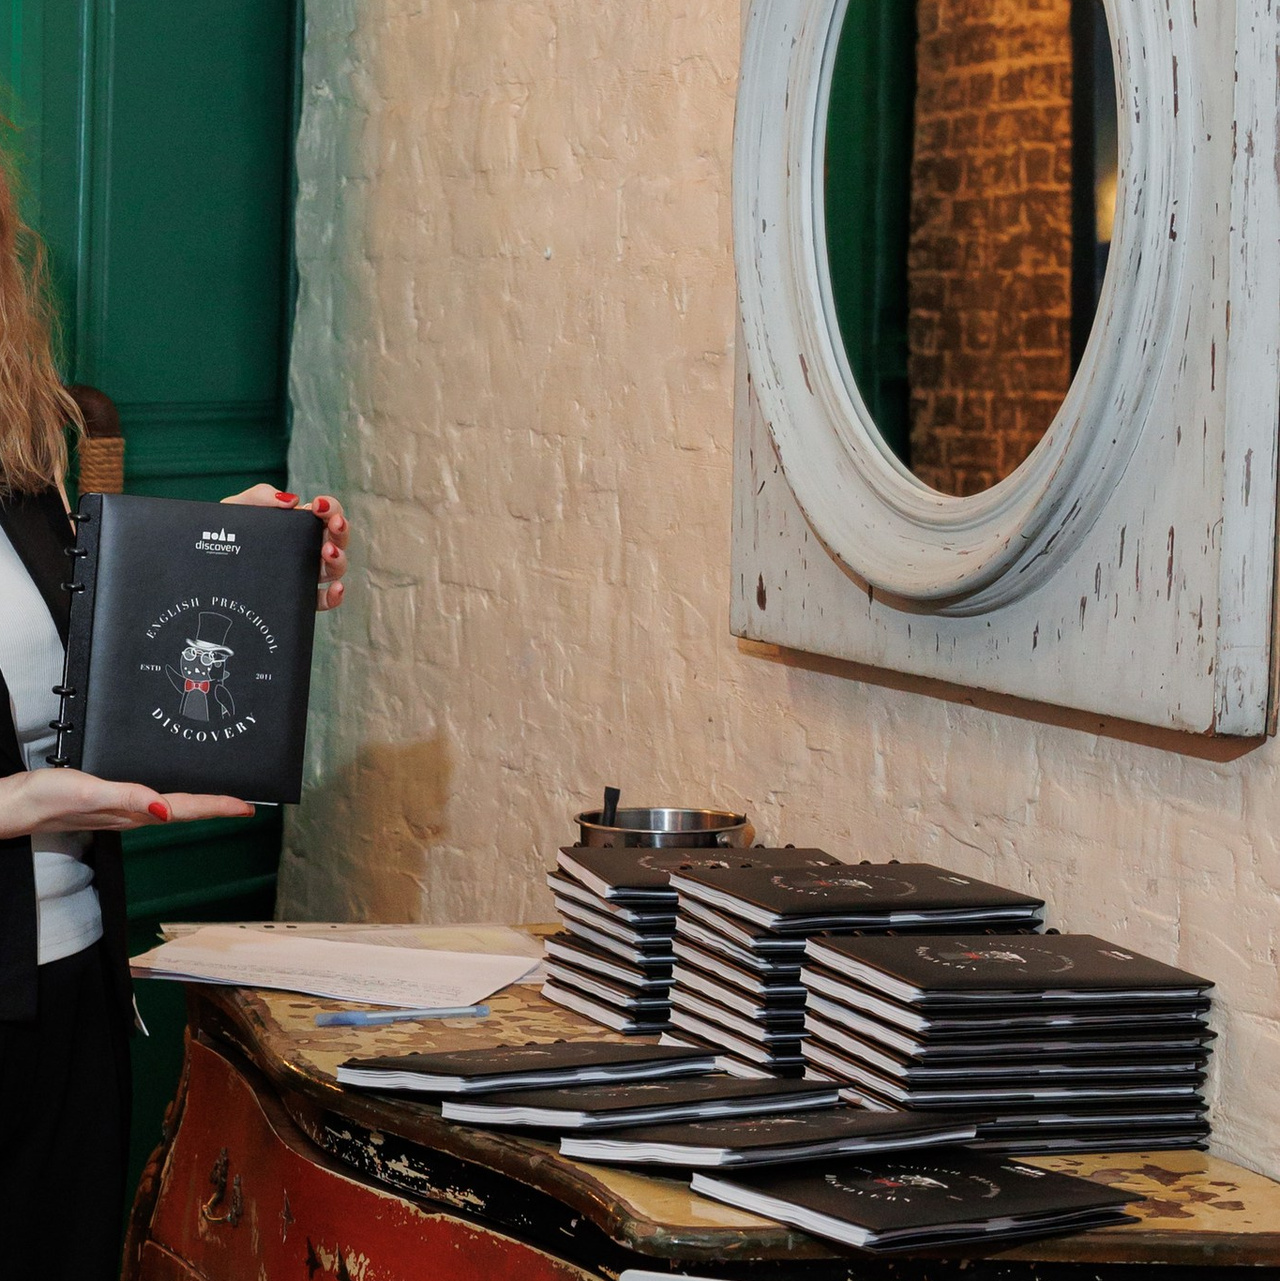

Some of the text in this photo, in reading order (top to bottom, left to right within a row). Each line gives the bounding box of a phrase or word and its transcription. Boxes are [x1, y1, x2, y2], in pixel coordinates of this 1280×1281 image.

[195, 540, 241, 555] discovery
[146, 596, 278, 654] ENGLISH PRESCHOOL
[140, 664, 161, 672] ESTD
[151, 707, 258, 742] DISCOVERY
